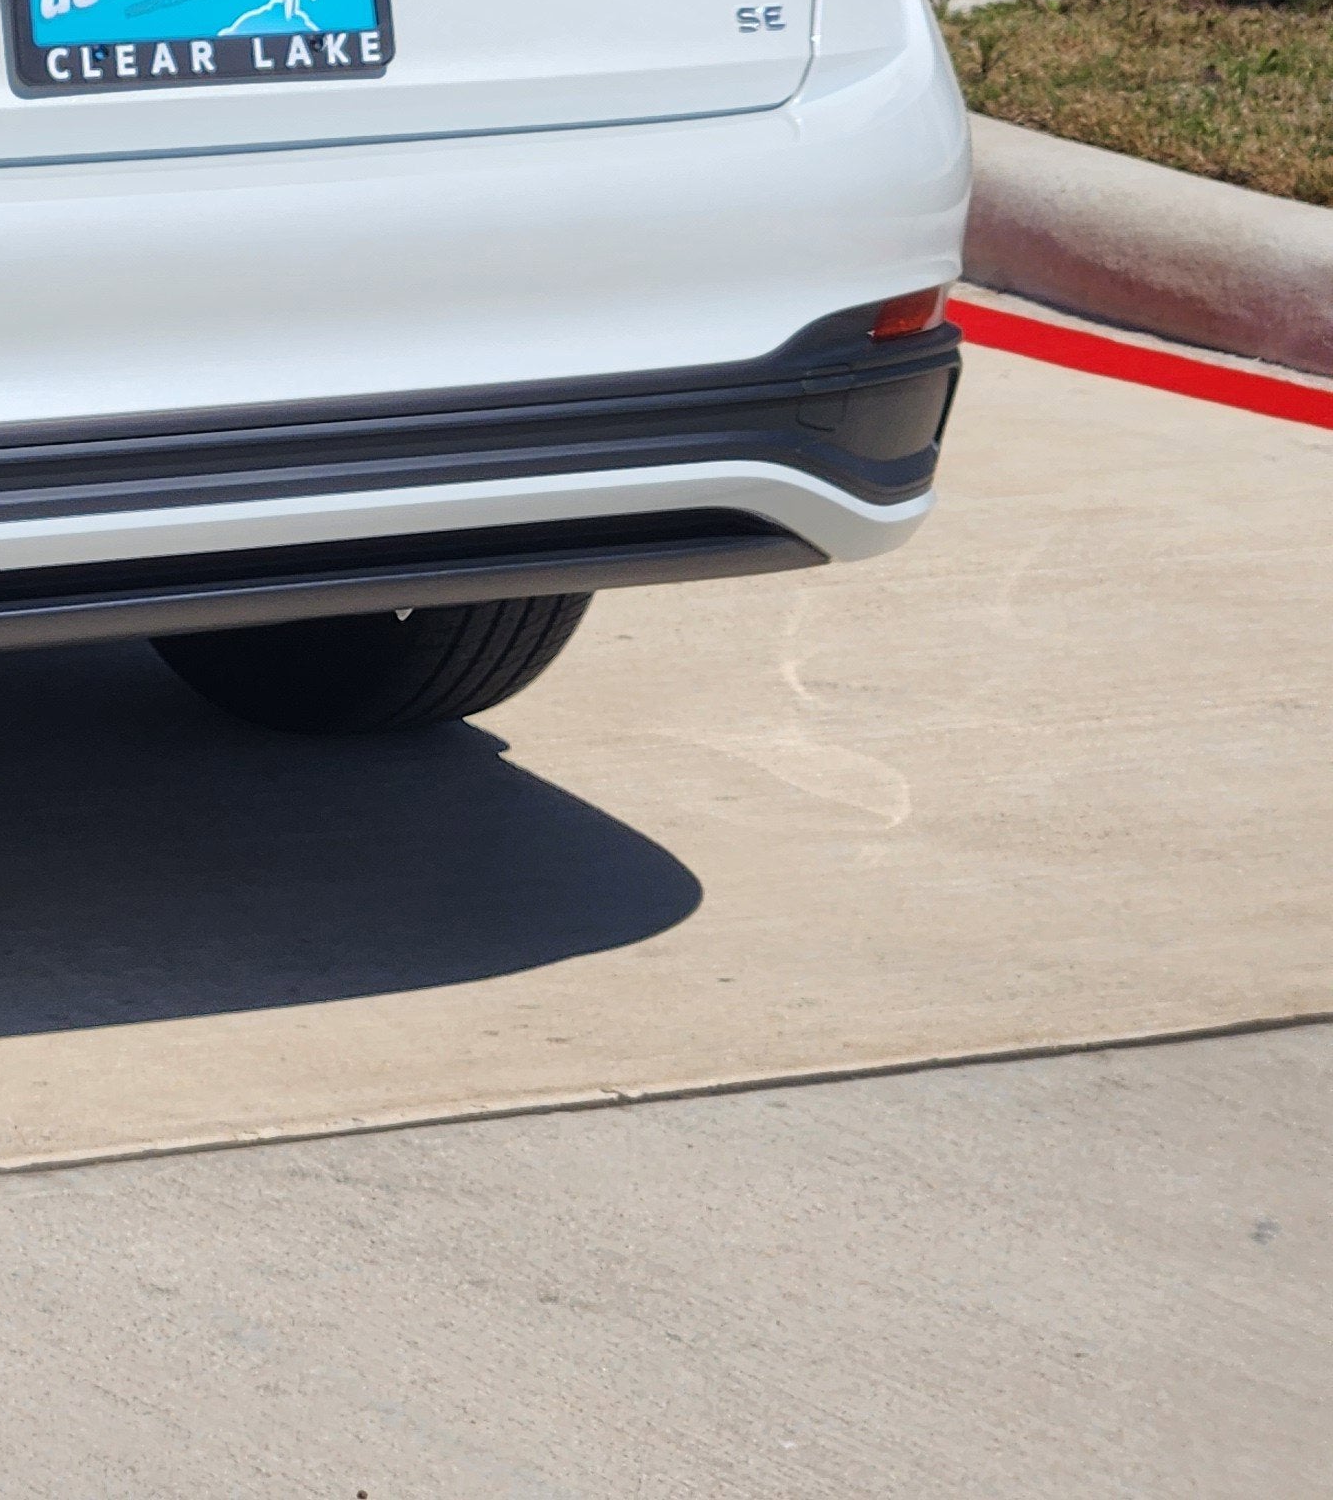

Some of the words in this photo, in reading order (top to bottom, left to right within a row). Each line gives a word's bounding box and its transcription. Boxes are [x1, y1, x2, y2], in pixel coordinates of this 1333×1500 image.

[736, 5, 786, 34] SE
[46, 42, 217, 82] CLEAR
[251, 31, 383, 70] LAKE
